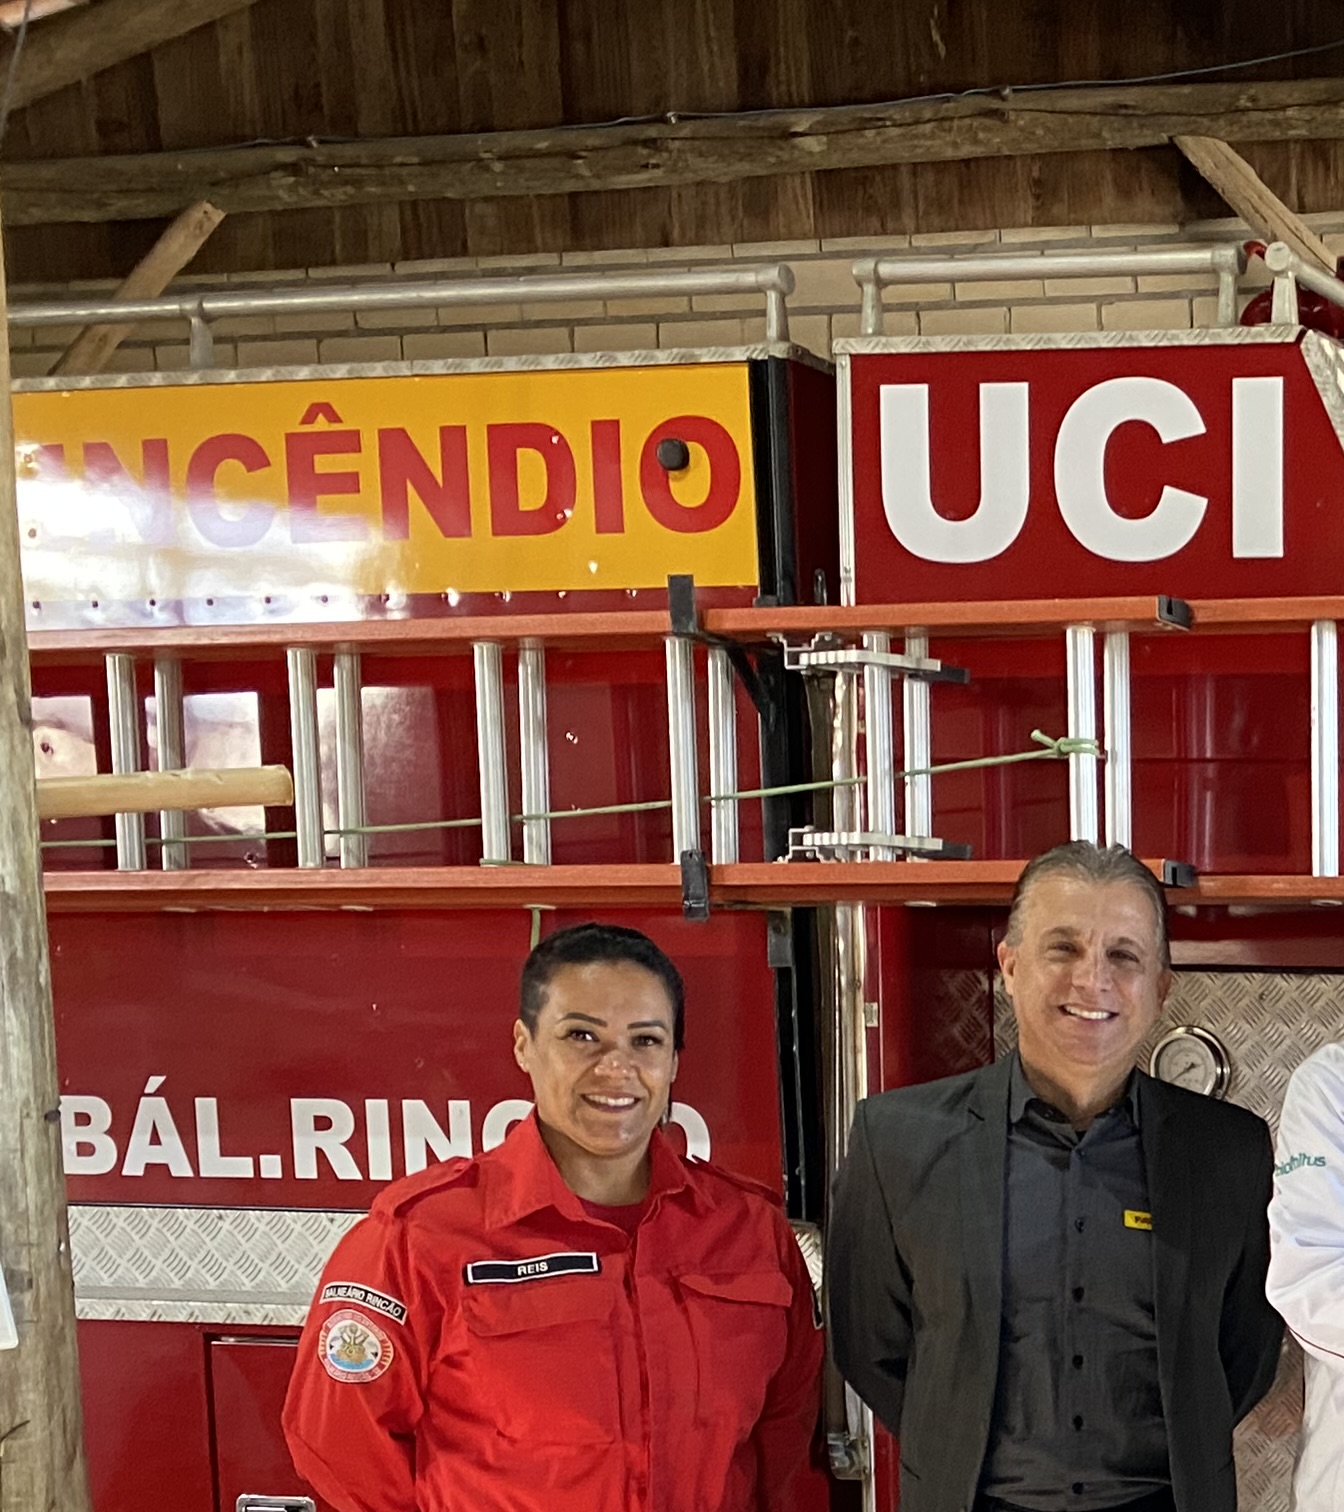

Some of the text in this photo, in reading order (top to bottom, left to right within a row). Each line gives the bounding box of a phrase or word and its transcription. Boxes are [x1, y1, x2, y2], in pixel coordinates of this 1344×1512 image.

[880, 376, 1285, 563] UCI
[59, 1076, 711, 1181] BÁL.RINC
[325, 1285, 402, 1317] BALNEÁRIO RINCÃO
[517, 1261, 548, 1276] REIS
